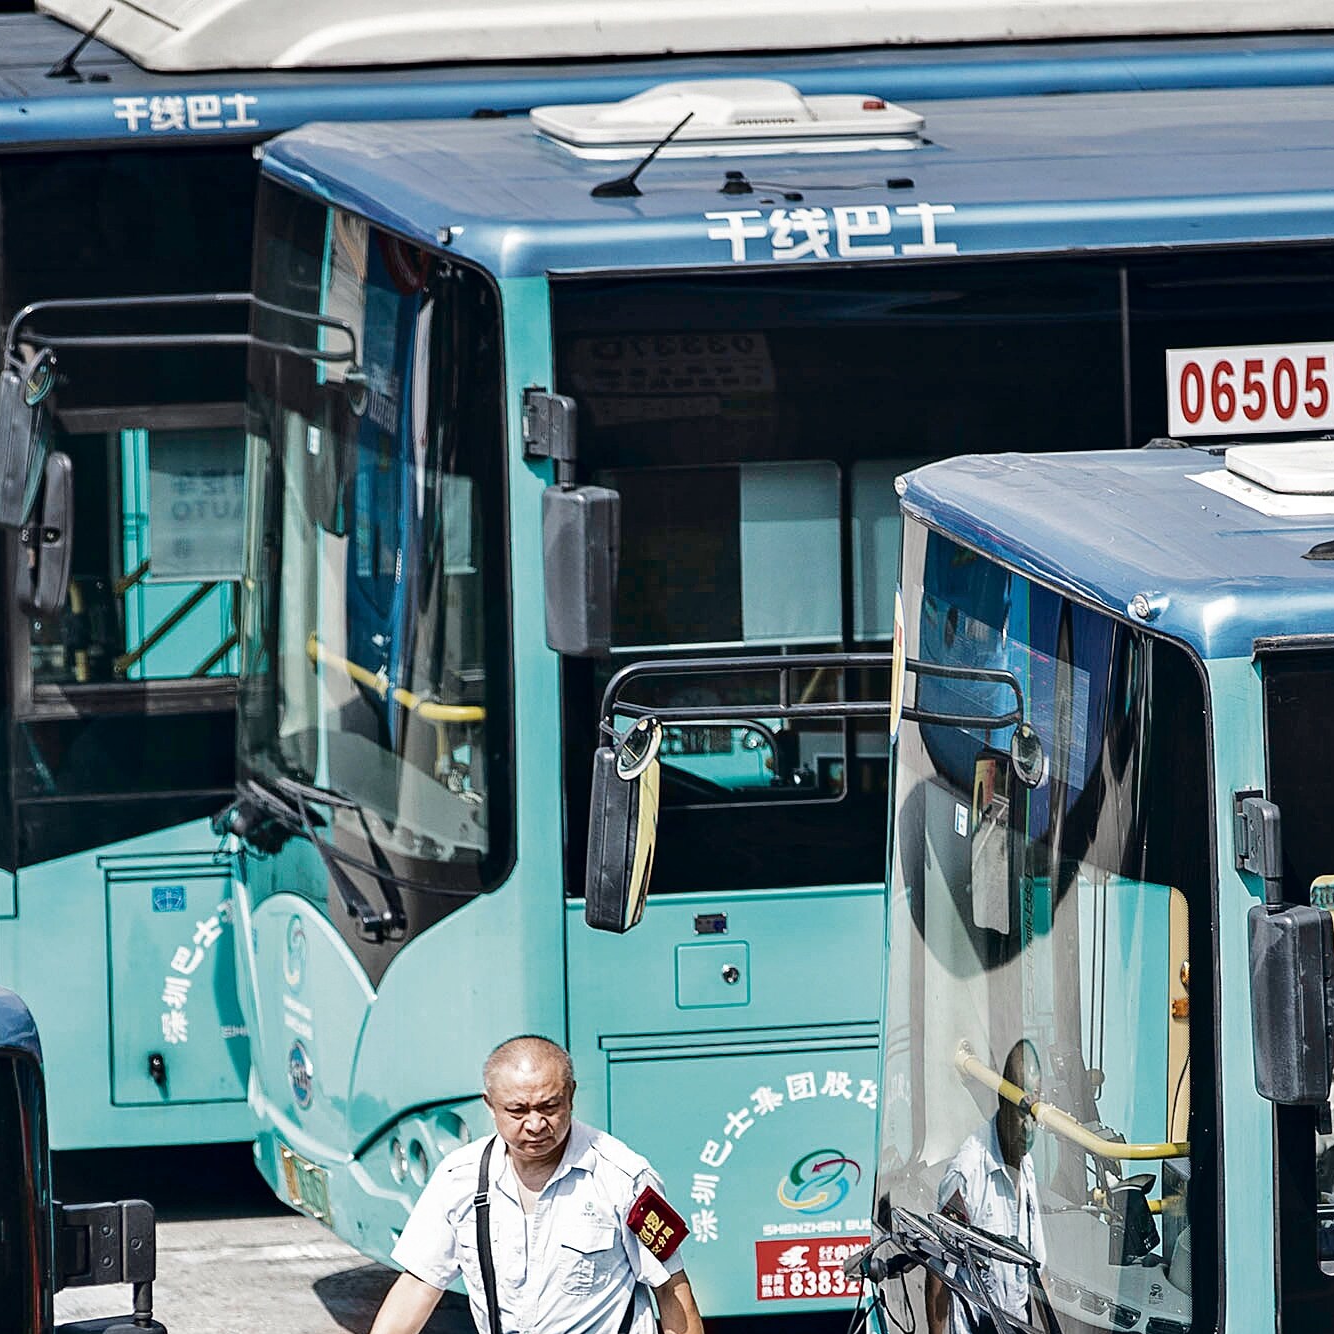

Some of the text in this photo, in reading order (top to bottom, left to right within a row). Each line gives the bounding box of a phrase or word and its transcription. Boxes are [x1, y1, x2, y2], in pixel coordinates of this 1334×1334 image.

[113, 93, 259, 131] 干线巴士
[704, 202, 960, 262] 干线巴士
[762, 1221, 842, 1236] SHENZHEN
